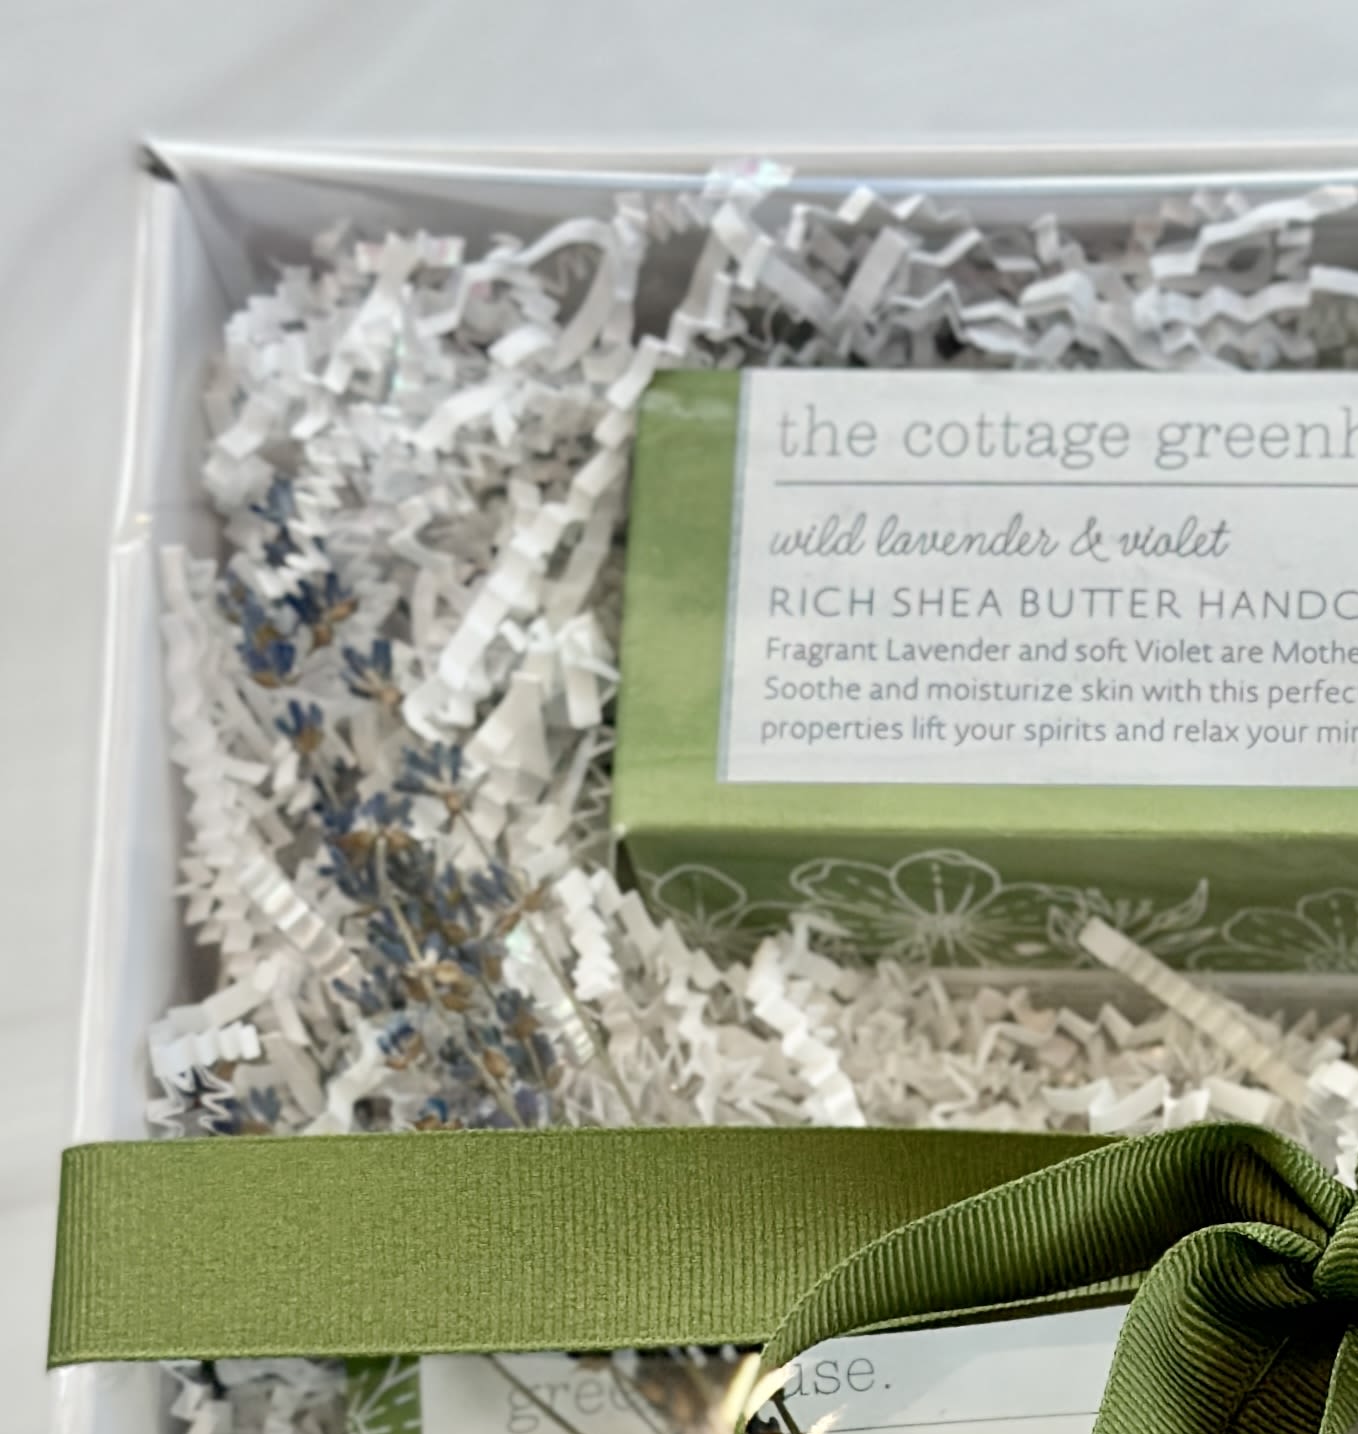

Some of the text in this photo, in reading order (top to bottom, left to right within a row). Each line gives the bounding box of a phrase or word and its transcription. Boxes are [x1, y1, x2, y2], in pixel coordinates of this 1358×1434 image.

[777, 404, 877, 459] the
[903, 412, 1130, 470] cottage
[770, 512, 1231, 562] wild lavender & violet
[768, 586, 875, 619] RICH
[892, 587, 1002, 619] SHEA
[1020, 588, 1181, 620] BUTTER
[766, 636, 878, 667] Fragrant
[886, 637, 1009, 663] Lavender
[1018, 638, 1068, 663] and
[1074, 638, 1128, 664] soft
[1135, 638, 1213, 664] Violet
[1220, 645, 1264, 664] are
[763, 676, 861, 702] Soothe
[870, 677, 918, 702] and
[927, 678, 1073, 702] moisturize
[1082, 678, 1133, 703] skin
[1142, 679, 1201, 703] with
[1210, 680, 1259, 704] this
[761, 717, 903, 743] properties
[912, 716, 946, 741] lift
[953, 722, 1015, 747] your
[1024, 718, 1106, 747] spirits
[1116, 719, 1165, 742] and
[1174, 720, 1239, 743] relax
[1246, 725, 1307, 749] your
